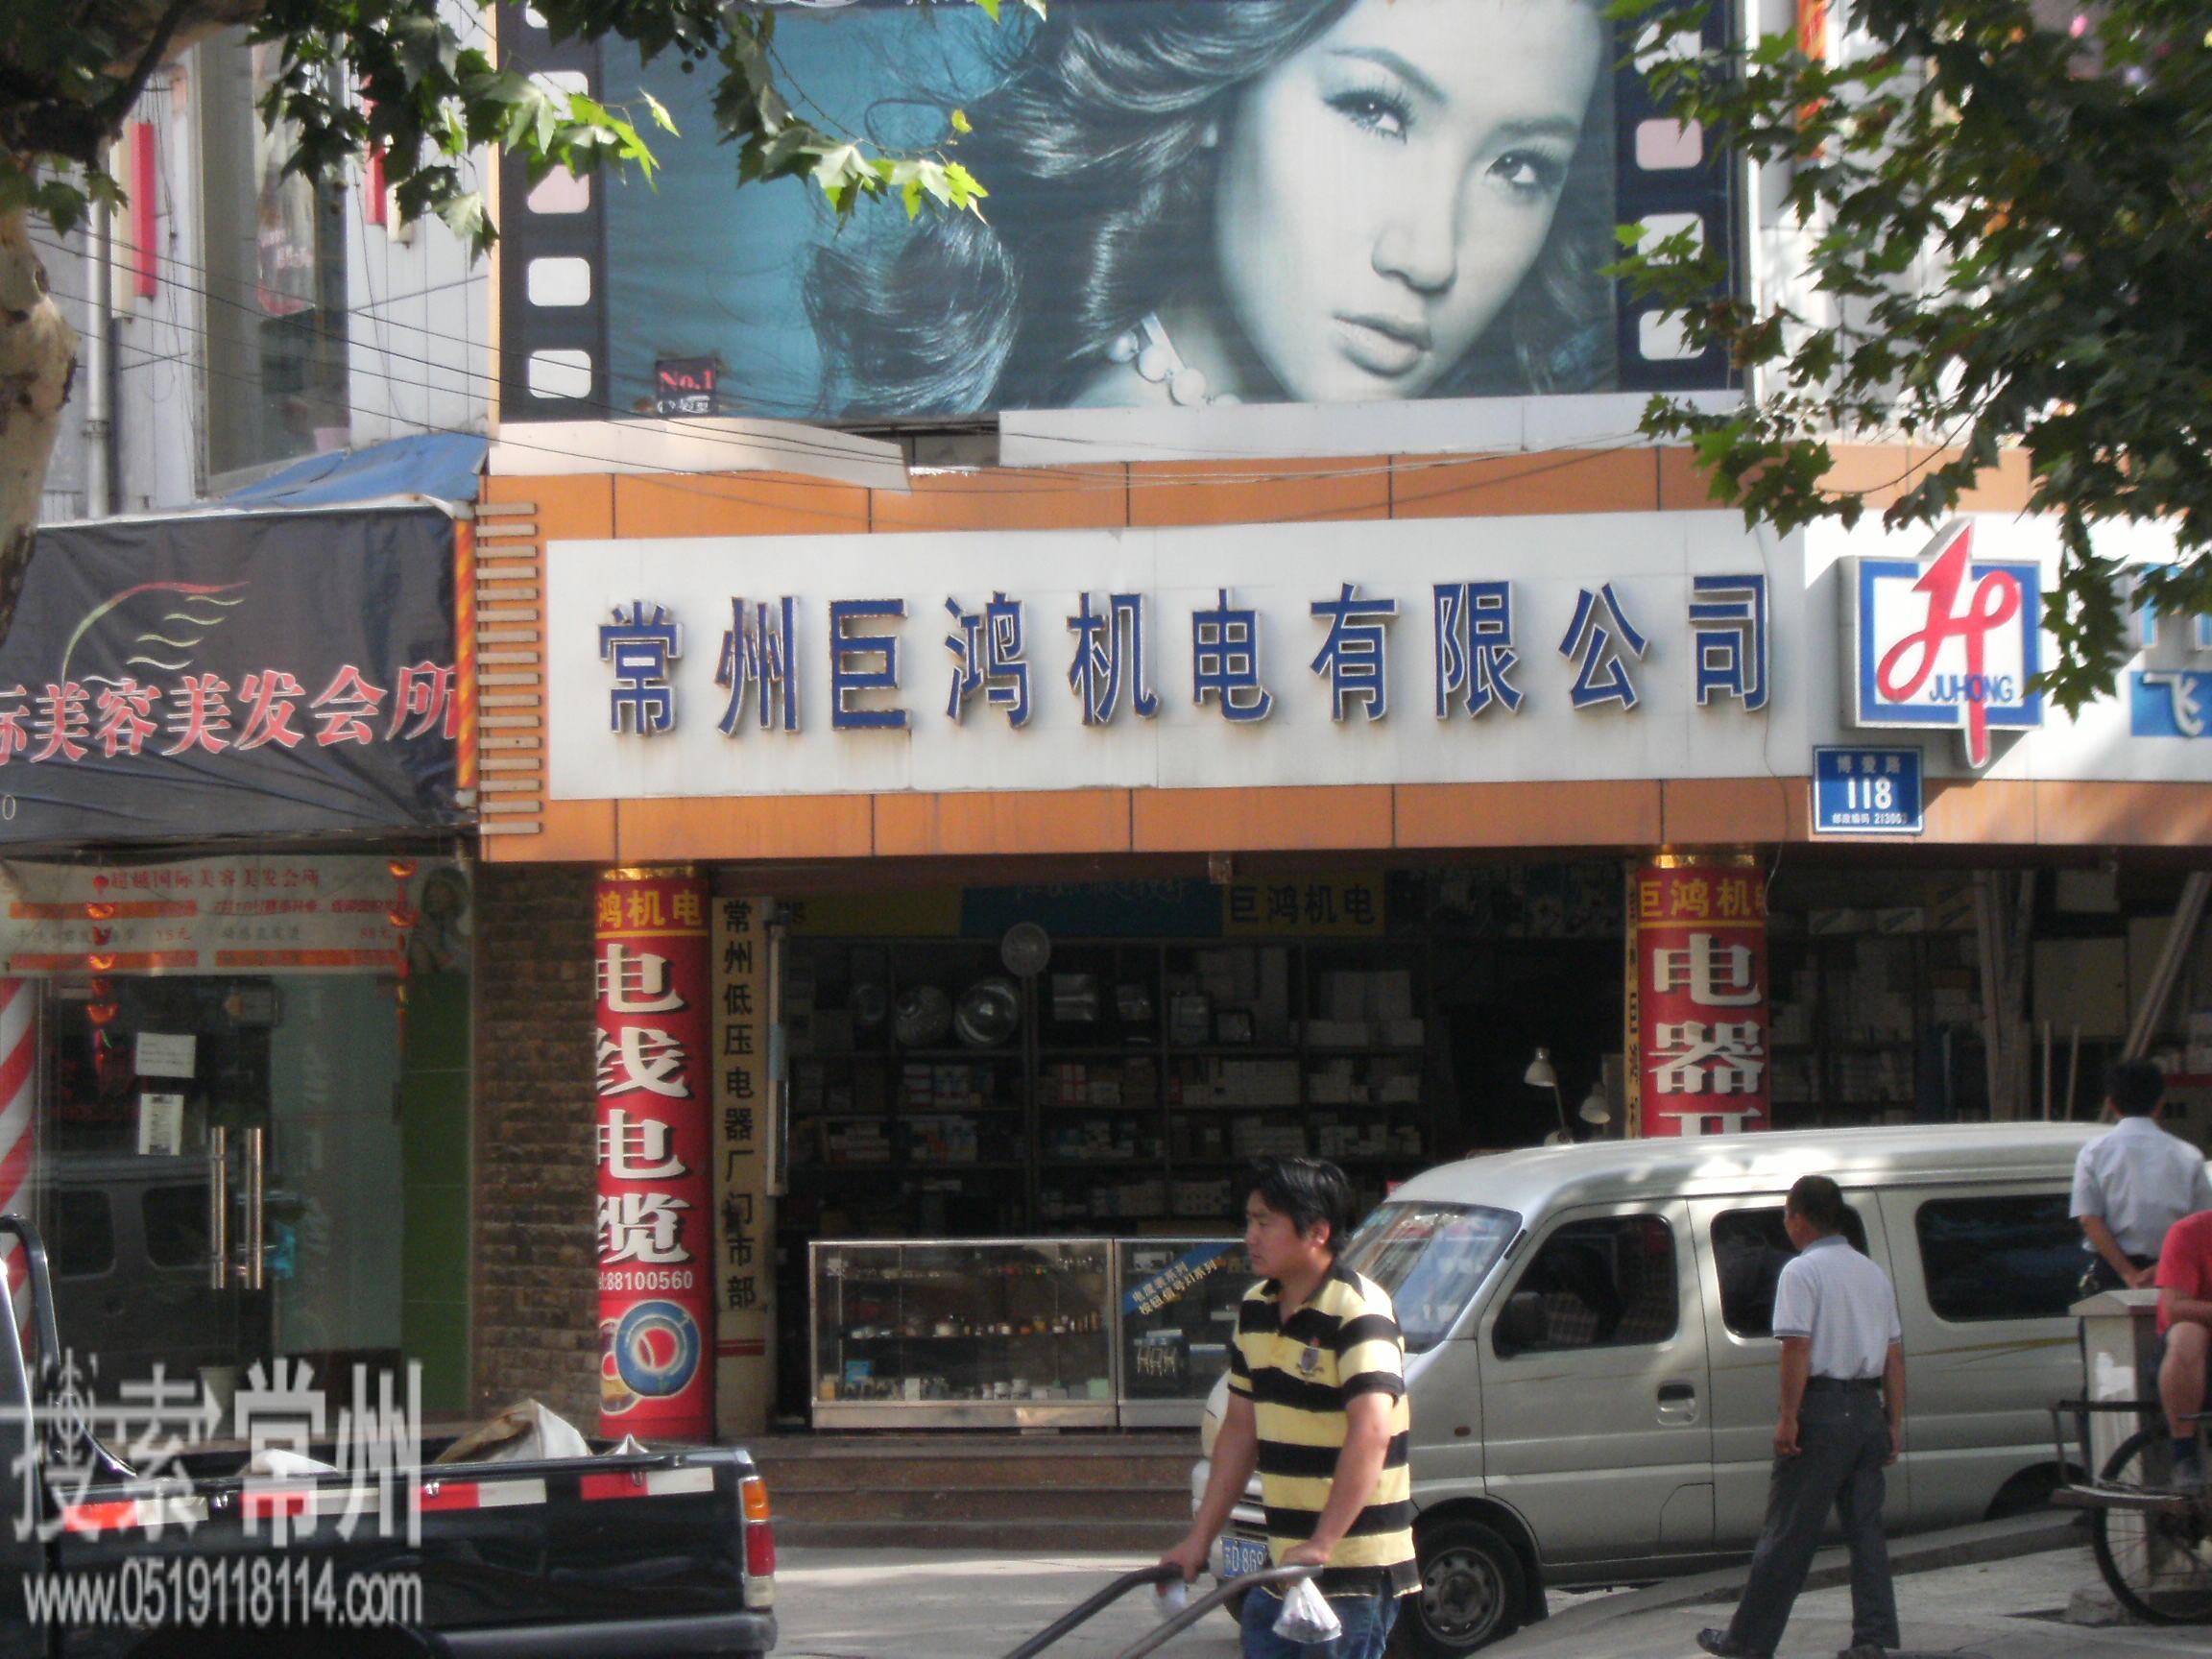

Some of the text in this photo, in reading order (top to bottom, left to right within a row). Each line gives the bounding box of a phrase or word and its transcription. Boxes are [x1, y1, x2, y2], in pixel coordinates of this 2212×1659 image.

[659, 370, 713, 392] No.1
[598, 574, 1768, 736] 常州巨鸿机电有限公司
[1929, 675, 2013, 702] JUHONG
[1847, 777, 1892, 809] 118
[598, 889, 703, 928] 鸿机电
[1230, 883, 1376, 926] 巨鸿机电
[596, 943, 691, 1263] 电线电缆
[722, 899, 758, 1310] 常州低压电器厂门市部
